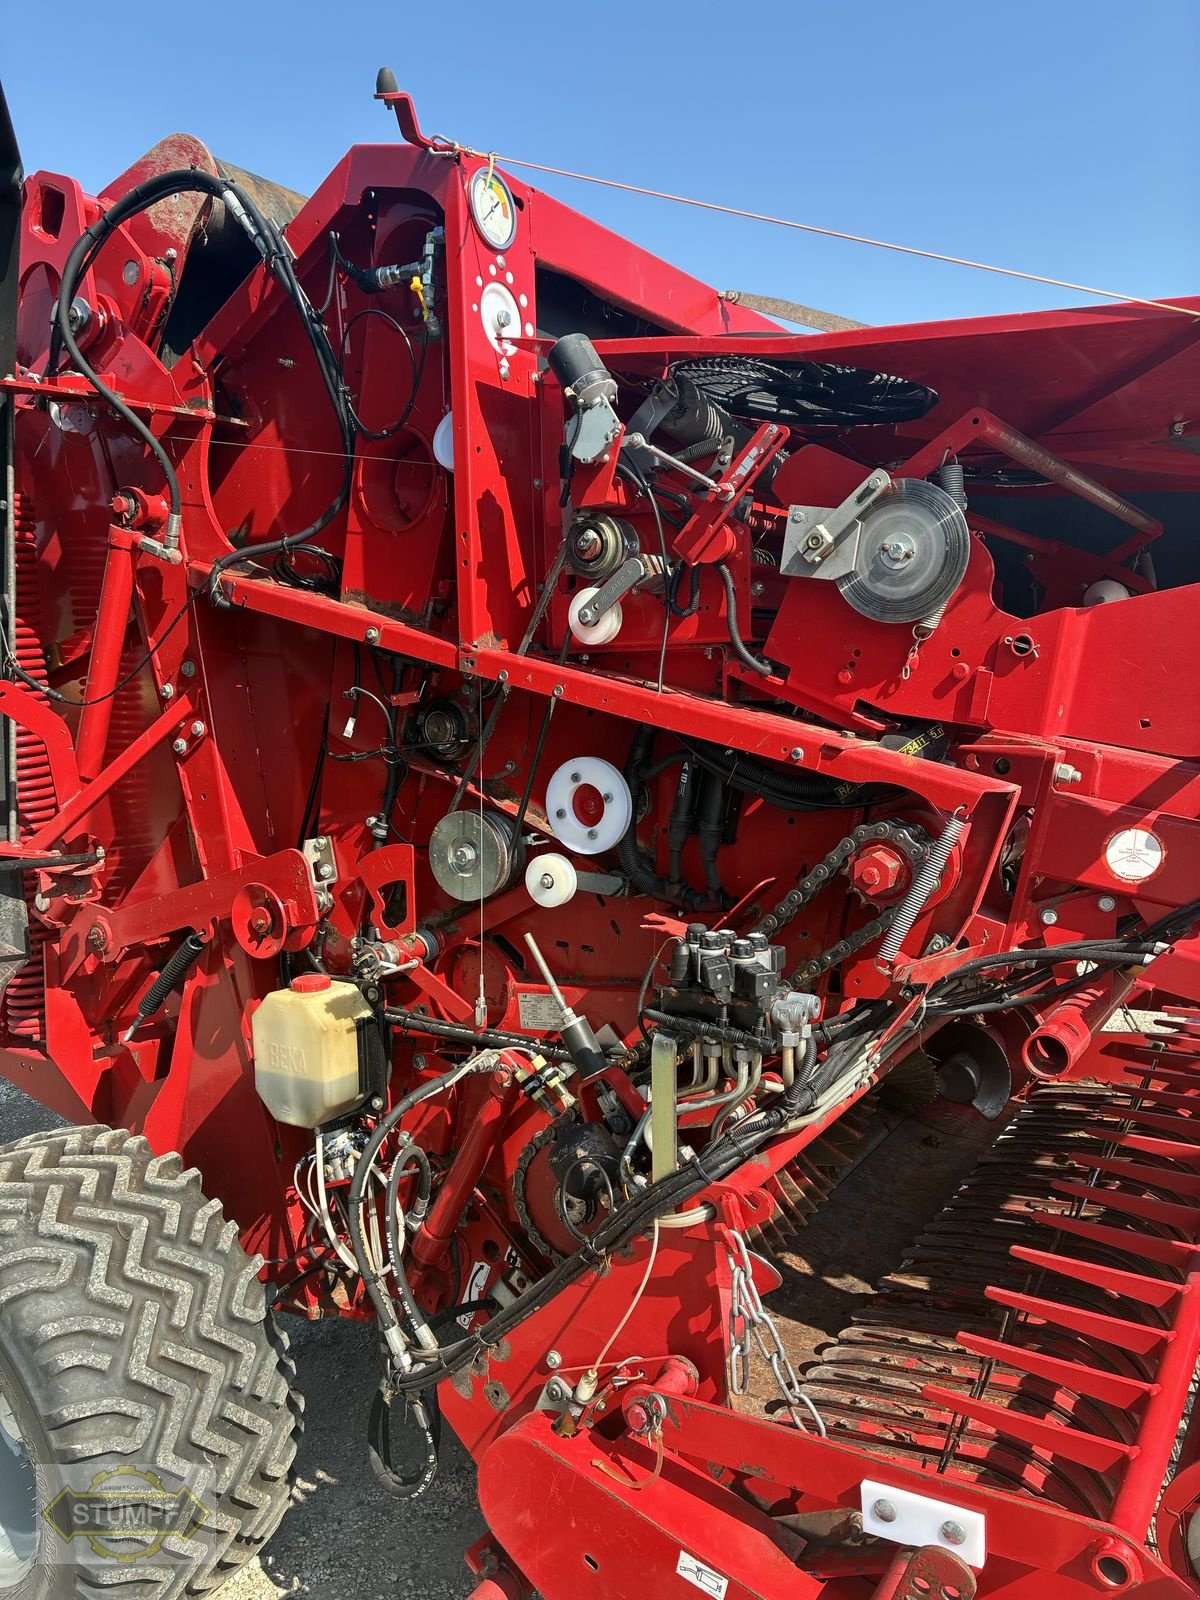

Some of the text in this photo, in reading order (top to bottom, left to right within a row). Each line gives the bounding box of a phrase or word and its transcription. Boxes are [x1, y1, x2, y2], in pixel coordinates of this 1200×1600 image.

[270, 1040, 308, 1075] BEKA
[426, 1431, 433, 1444] WP
[428, 1454, 435, 1463] 10
